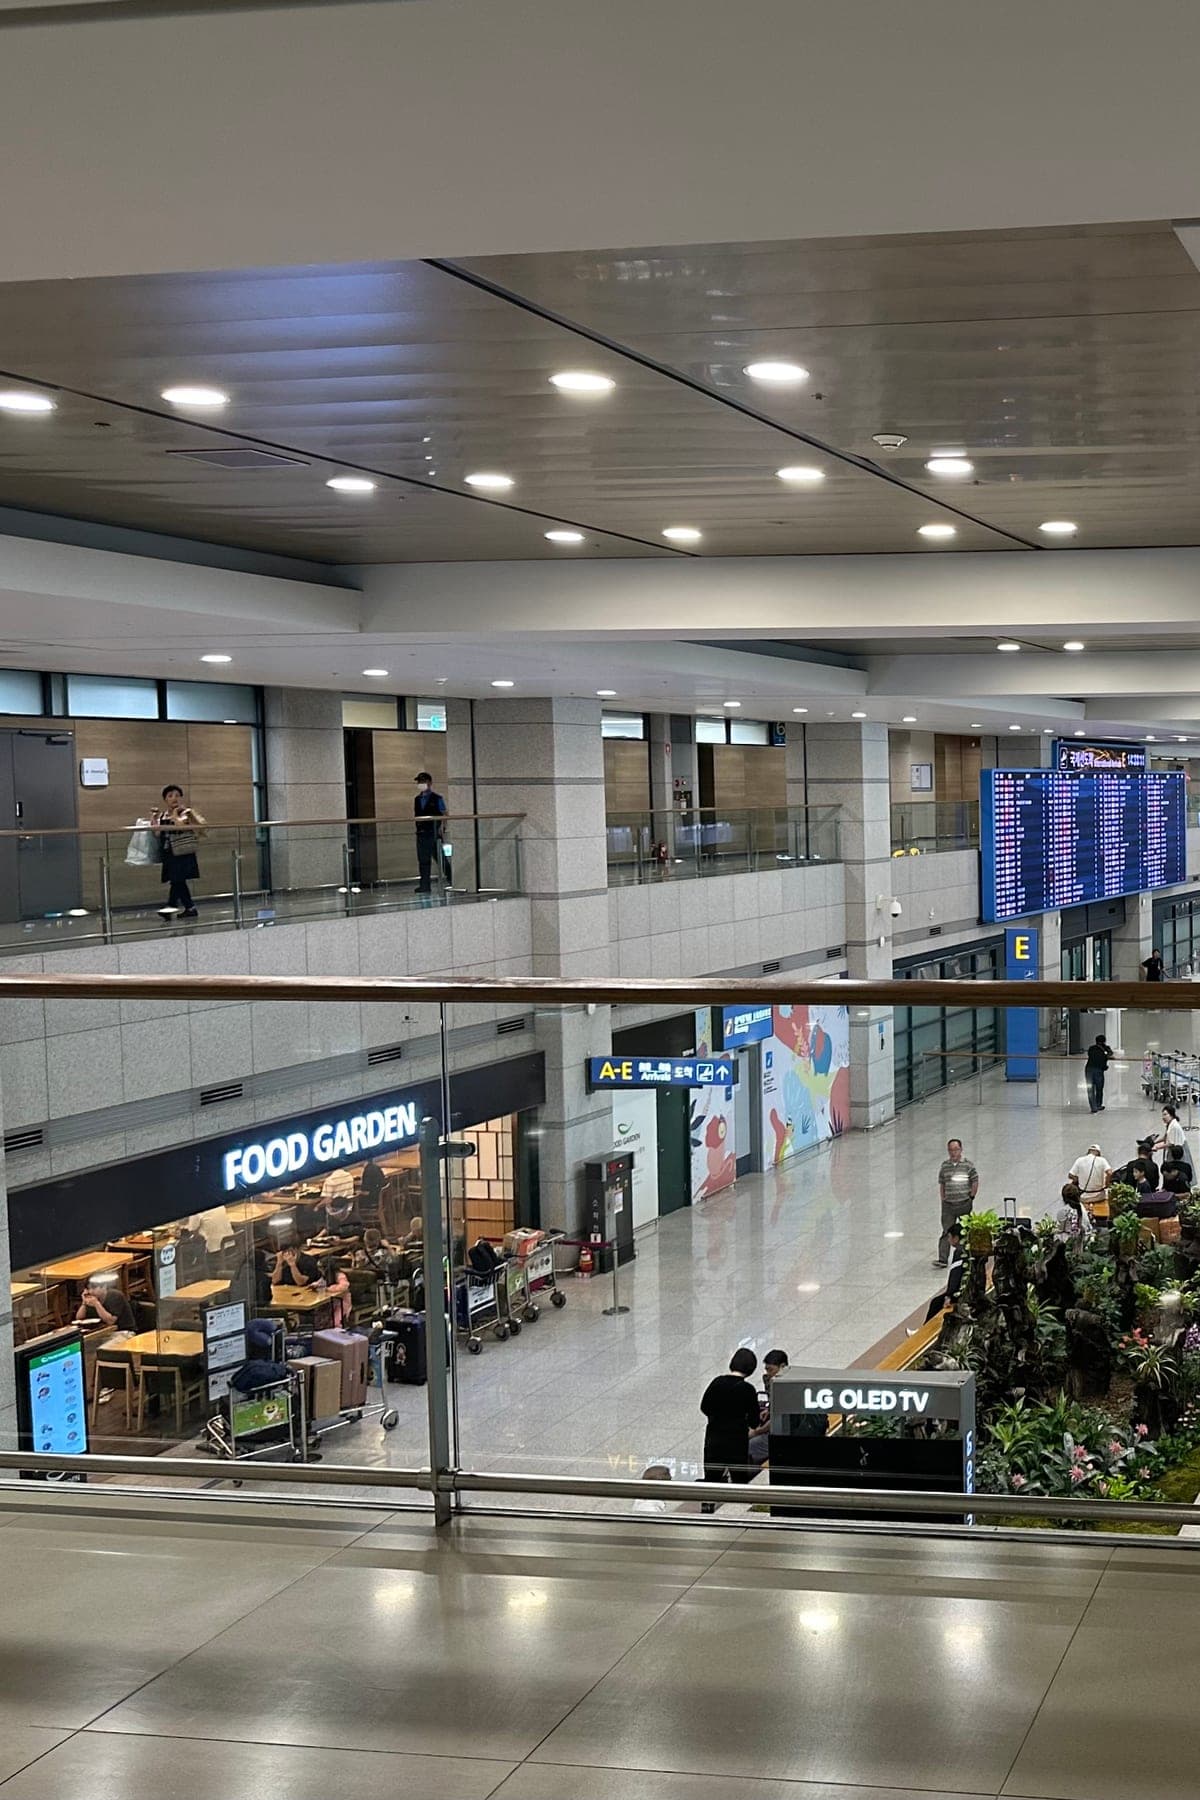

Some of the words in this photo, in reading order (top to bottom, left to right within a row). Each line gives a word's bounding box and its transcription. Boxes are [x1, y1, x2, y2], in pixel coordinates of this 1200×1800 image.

[1015, 936, 1030, 960] E
[599, 1061, 633, 1080] A-E
[222, 1131, 308, 1191] FOOD
[313, 1102, 418, 1162] GARDEN
[804, 1388, 834, 1409] LG
[839, 1389, 897, 1410] OLED
[899, 1391, 930, 1412] TV
